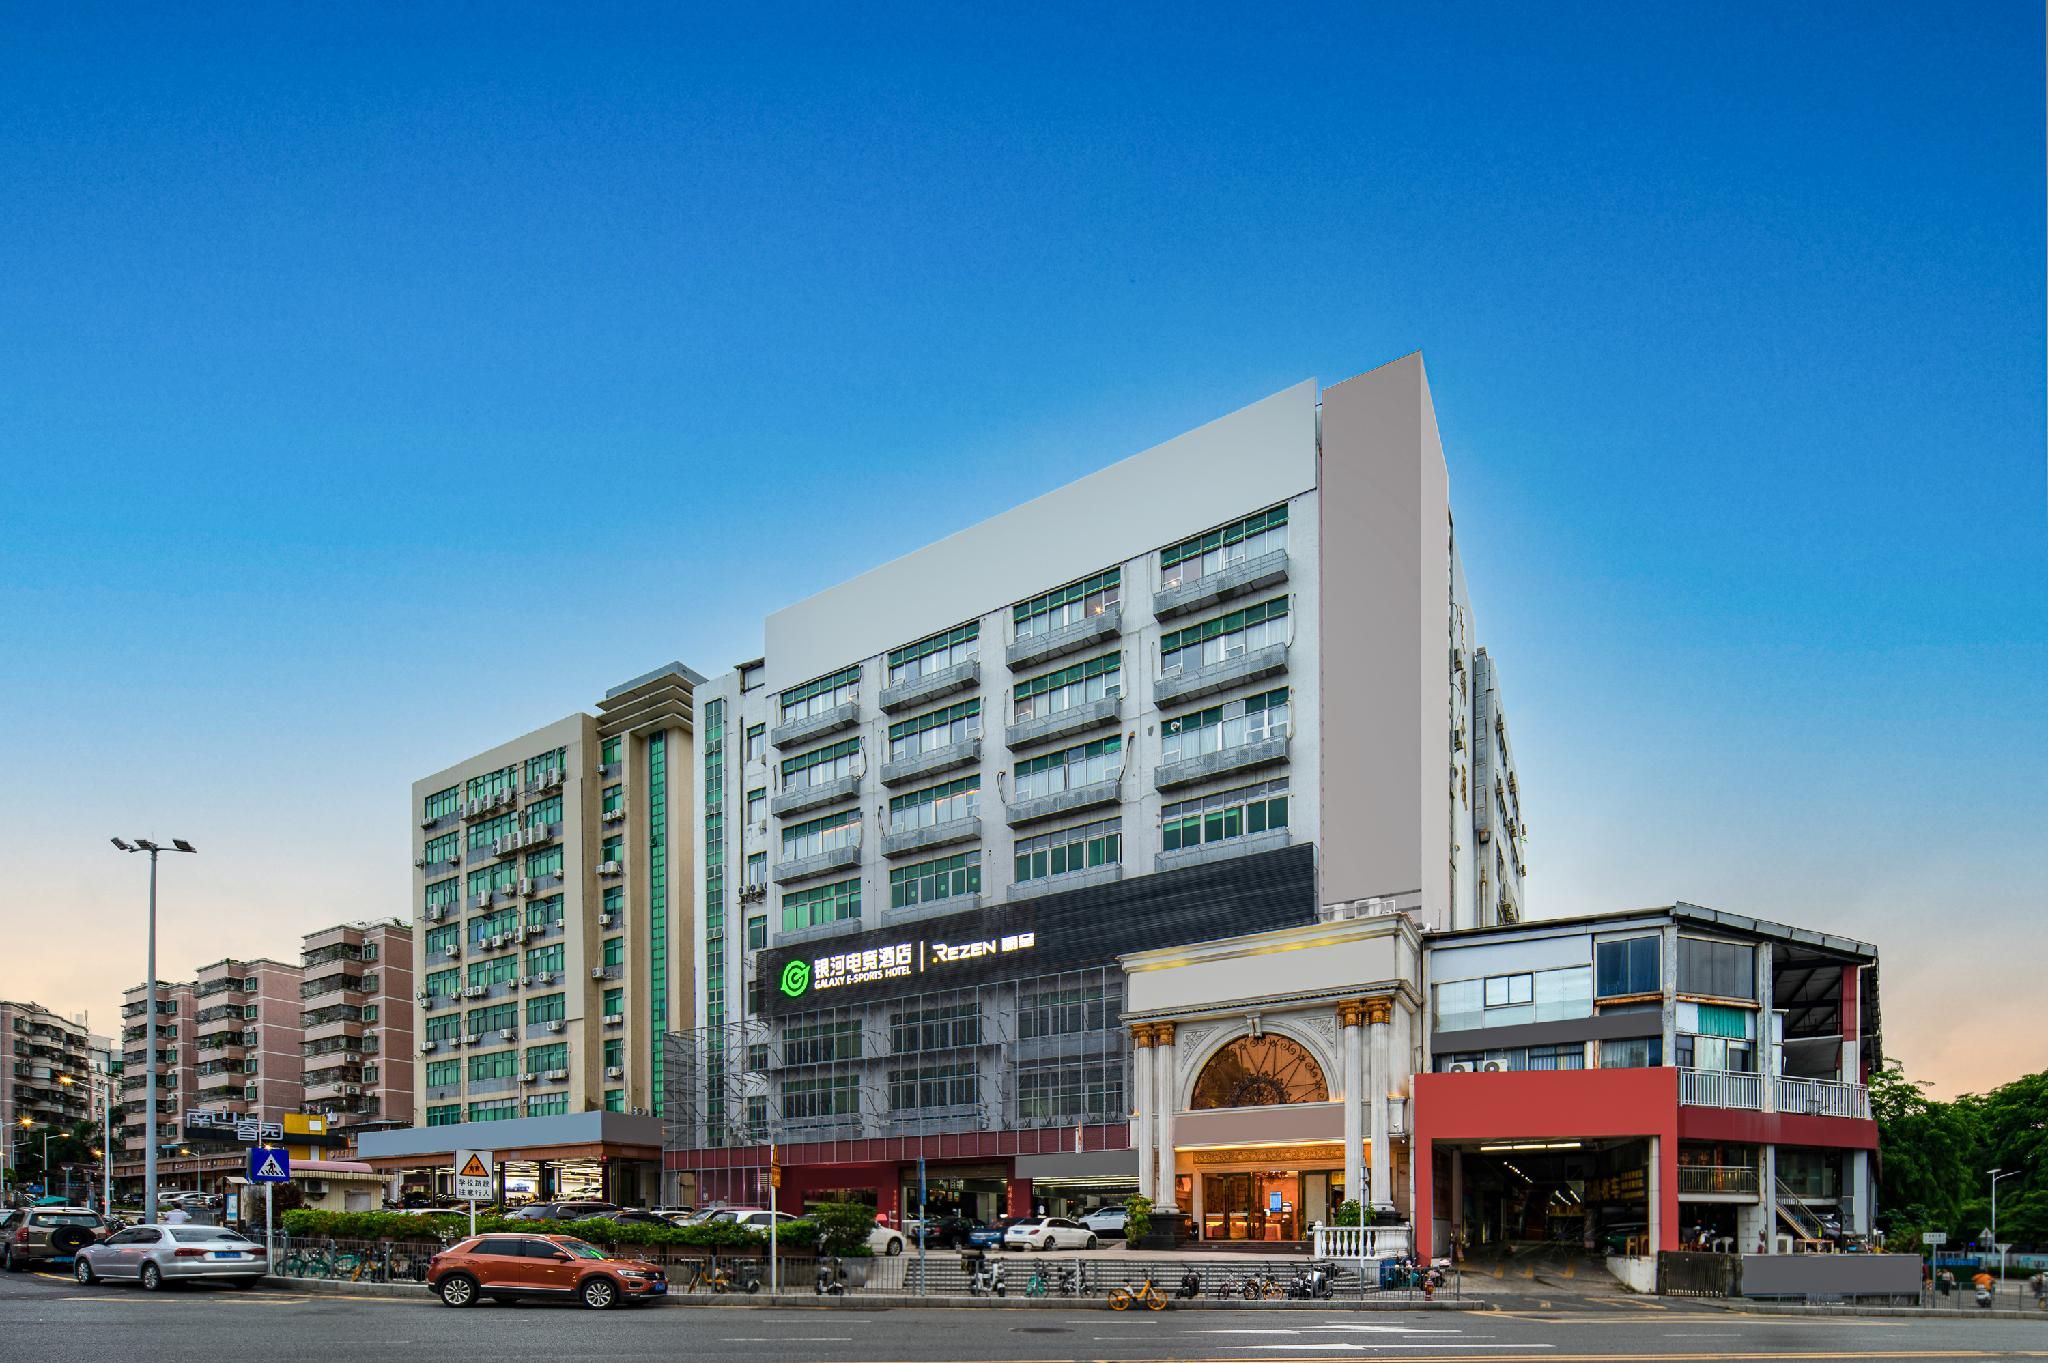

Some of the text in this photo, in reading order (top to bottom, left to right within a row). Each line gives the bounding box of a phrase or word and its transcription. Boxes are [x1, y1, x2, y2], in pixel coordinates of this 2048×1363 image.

[814, 943, 912, 980] 银河电竞酒店
[932, 939, 996, 963] REZEN
[814, 965, 911, 990] GALAXY E-SPORTS HOTEL
[459, 1189, 490, 1197] 注意行人
